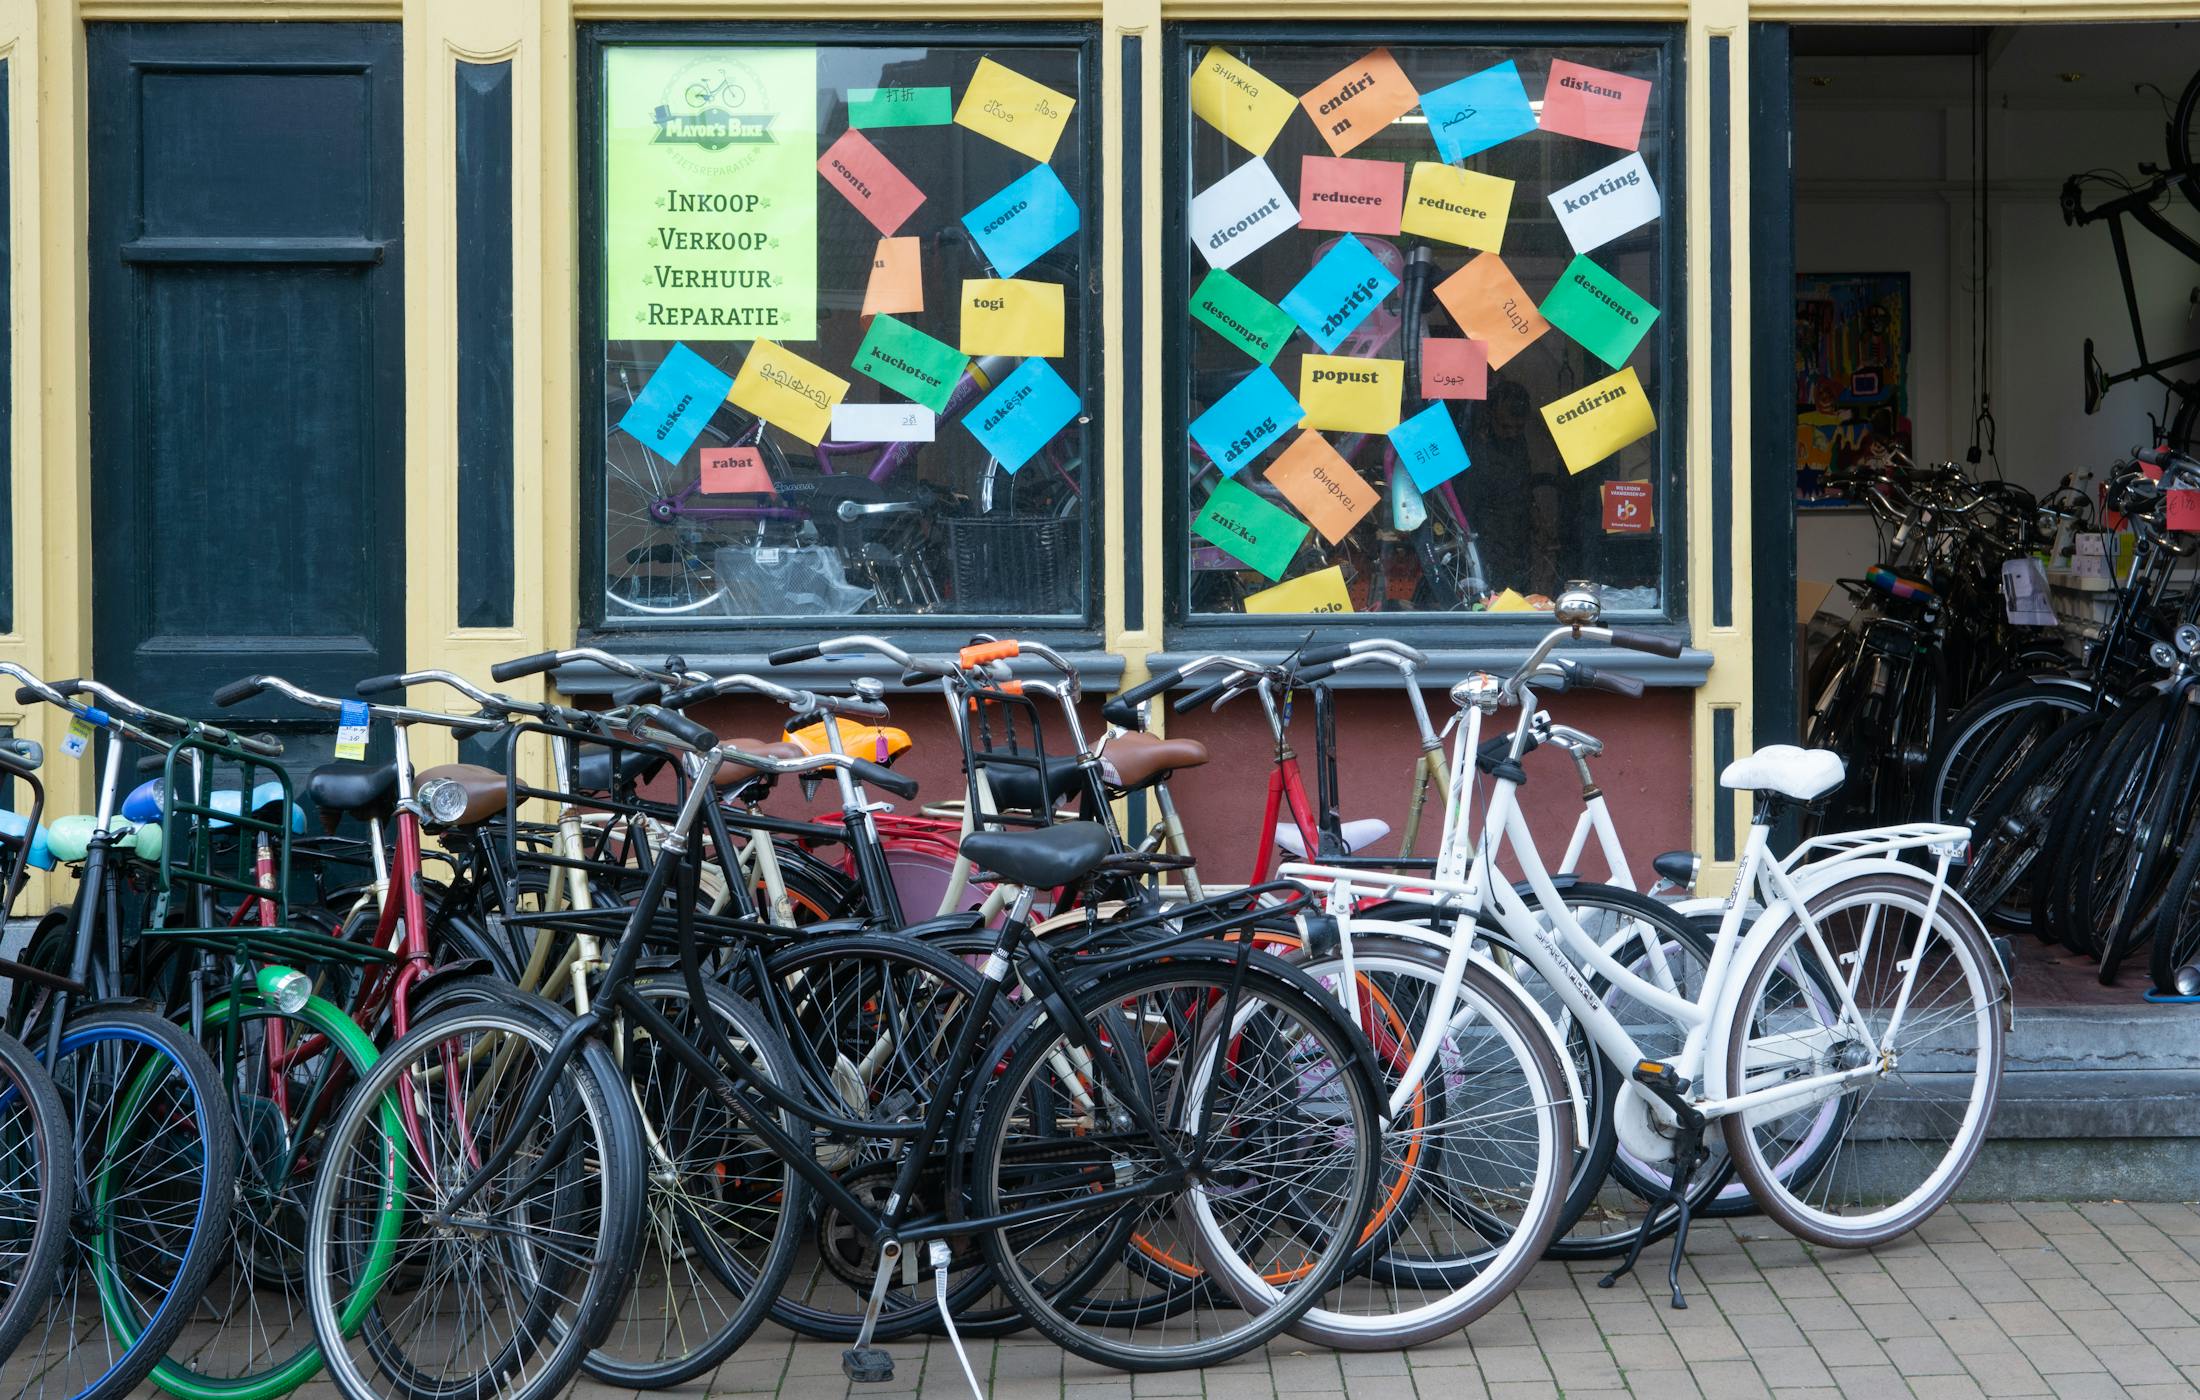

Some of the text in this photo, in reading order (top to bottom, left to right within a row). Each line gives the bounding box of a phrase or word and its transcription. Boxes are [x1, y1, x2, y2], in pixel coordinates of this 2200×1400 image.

[1212, 63, 1259, 98] знижка
[1560, 76, 1622, 100] diskaun
[886, 87, 915, 103] 打折
[1319, 72, 1376, 116] endiri
[728, 118, 763, 137] BIKE
[1332, 117, 1353, 136] m
[832, 159, 872, 200] scontu
[1563, 168, 1640, 214] korting
[667, 189, 759, 213] INKOOP
[1312, 191, 1382, 206] reducere
[1418, 195, 1487, 219] reducere
[983, 199, 1027, 235] sconto
[1209, 197, 1281, 250] dicount
[658, 227, 768, 251] VERKOOP
[654, 265, 772, 289] VERHUUR
[973, 297, 1005, 312] togi
[1320, 275, 1380, 337] zbritje
[1573, 273, 1639, 326] descuento
[648, 303, 779, 326] REPARATIE
[1202, 300, 1270, 351] descompte
[863, 363, 873, 374] a
[870, 346, 942, 388] kuchotser
[1312, 369, 1379, 385] popust
[1556, 383, 1627, 425] endirim
[656, 393, 694, 441] diskon
[1224, 416, 1278, 463] afslag
[712, 457, 753, 469] rabat
